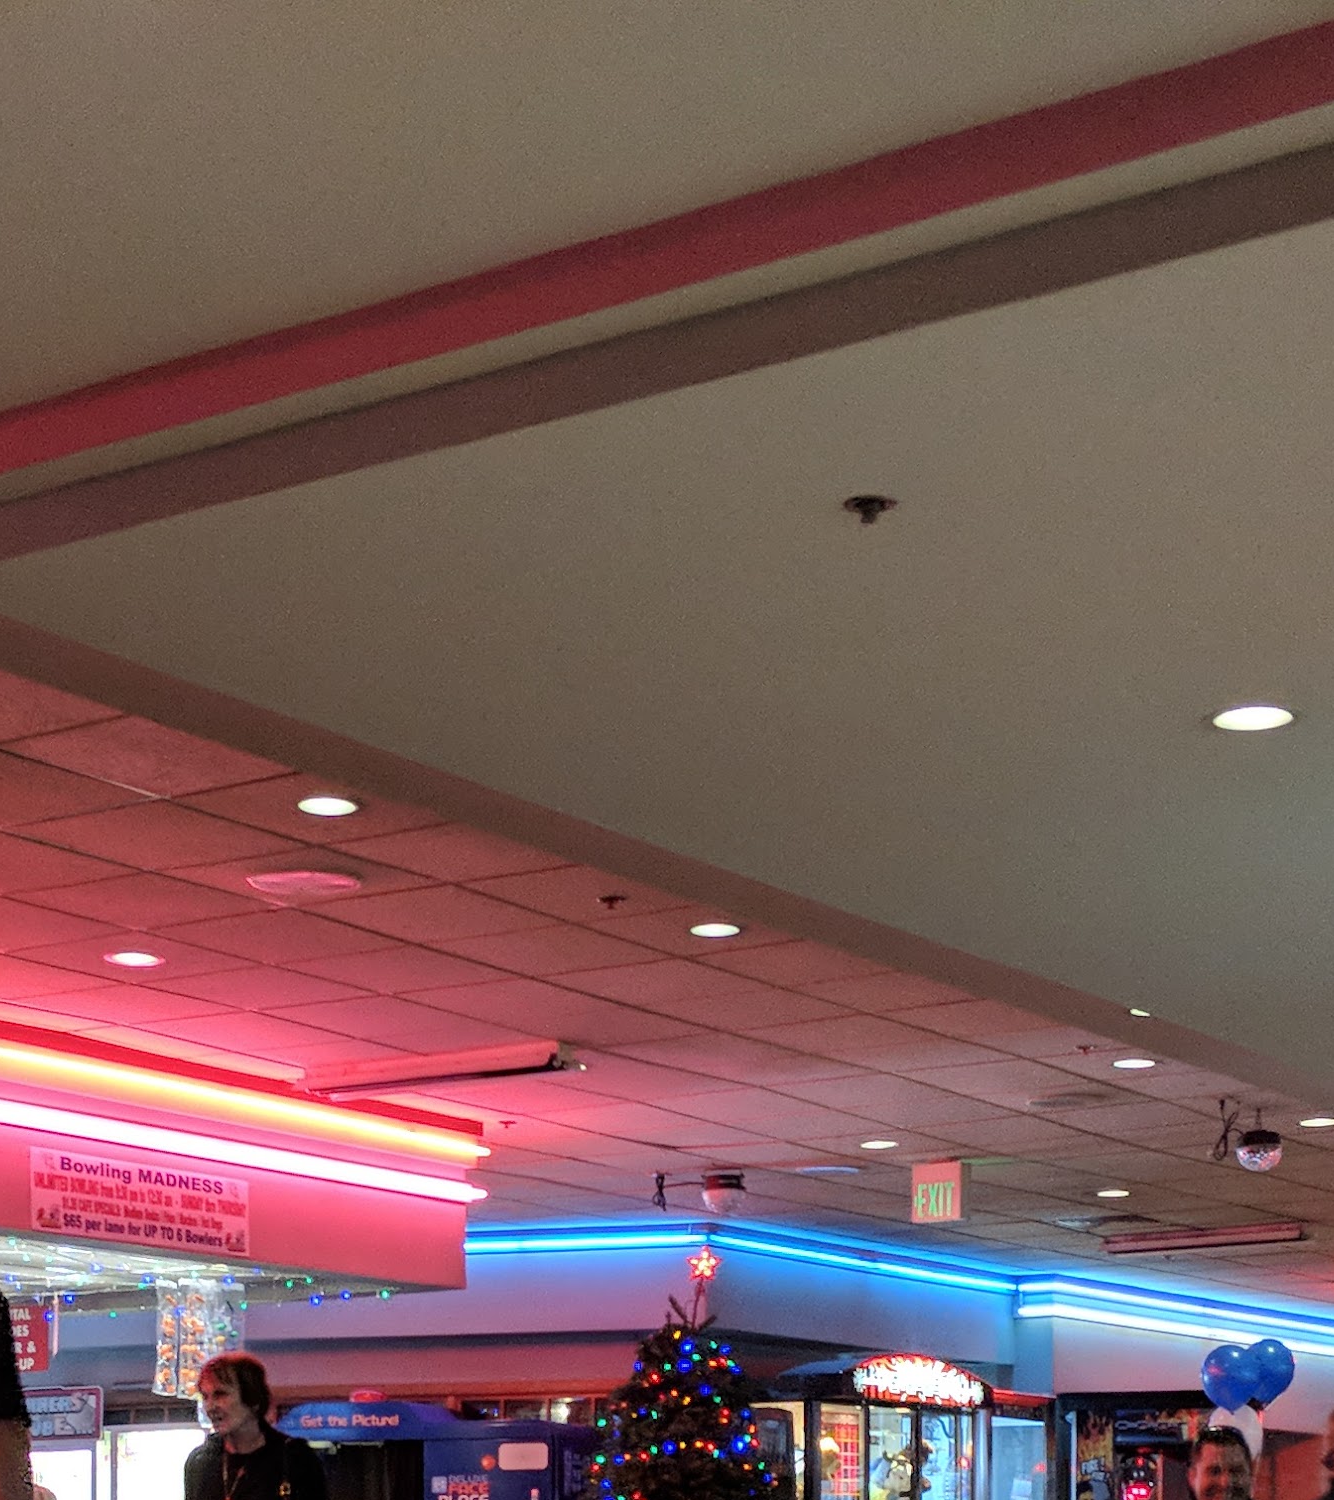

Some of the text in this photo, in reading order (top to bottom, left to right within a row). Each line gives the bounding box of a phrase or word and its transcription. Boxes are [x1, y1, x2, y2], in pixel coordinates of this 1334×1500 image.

[61, 1156, 223, 1195] Bowling MADNESS
[917, 1182, 955, 1218] EXIT
[63, 1213, 223, 1247] $65 per lane for UP TO 6 Bowlers
[27, 1340, 36, 1353] &
[300, 1414, 399, 1428] Get the Picture!
[447, 1482, 490, 1495] FACE
